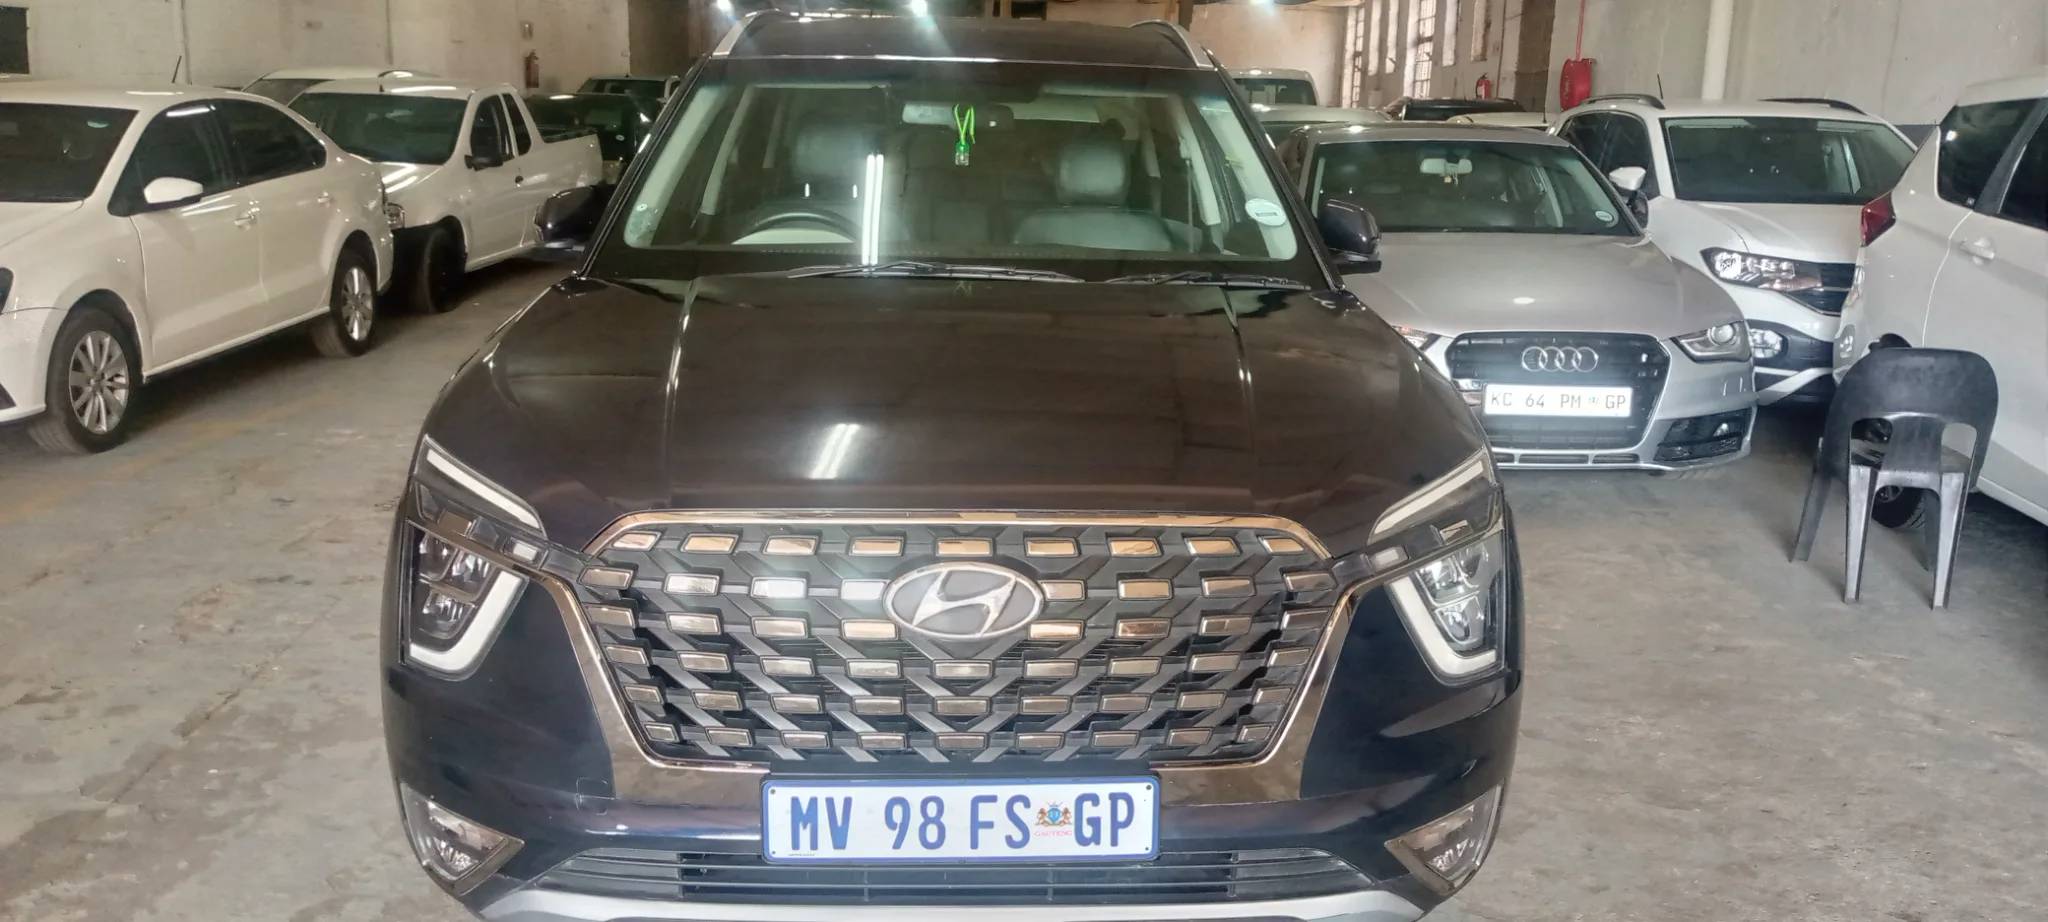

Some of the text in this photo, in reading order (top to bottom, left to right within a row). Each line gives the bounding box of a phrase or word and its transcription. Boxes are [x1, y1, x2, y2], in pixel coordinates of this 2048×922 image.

[1491, 392, 1512, 406] KC
[1525, 393, 1545, 408] 64
[1560, 394, 1581, 408] PM
[1605, 394, 1626, 409] GP
[790, 791, 1134, 851] MV 98 FS GP
